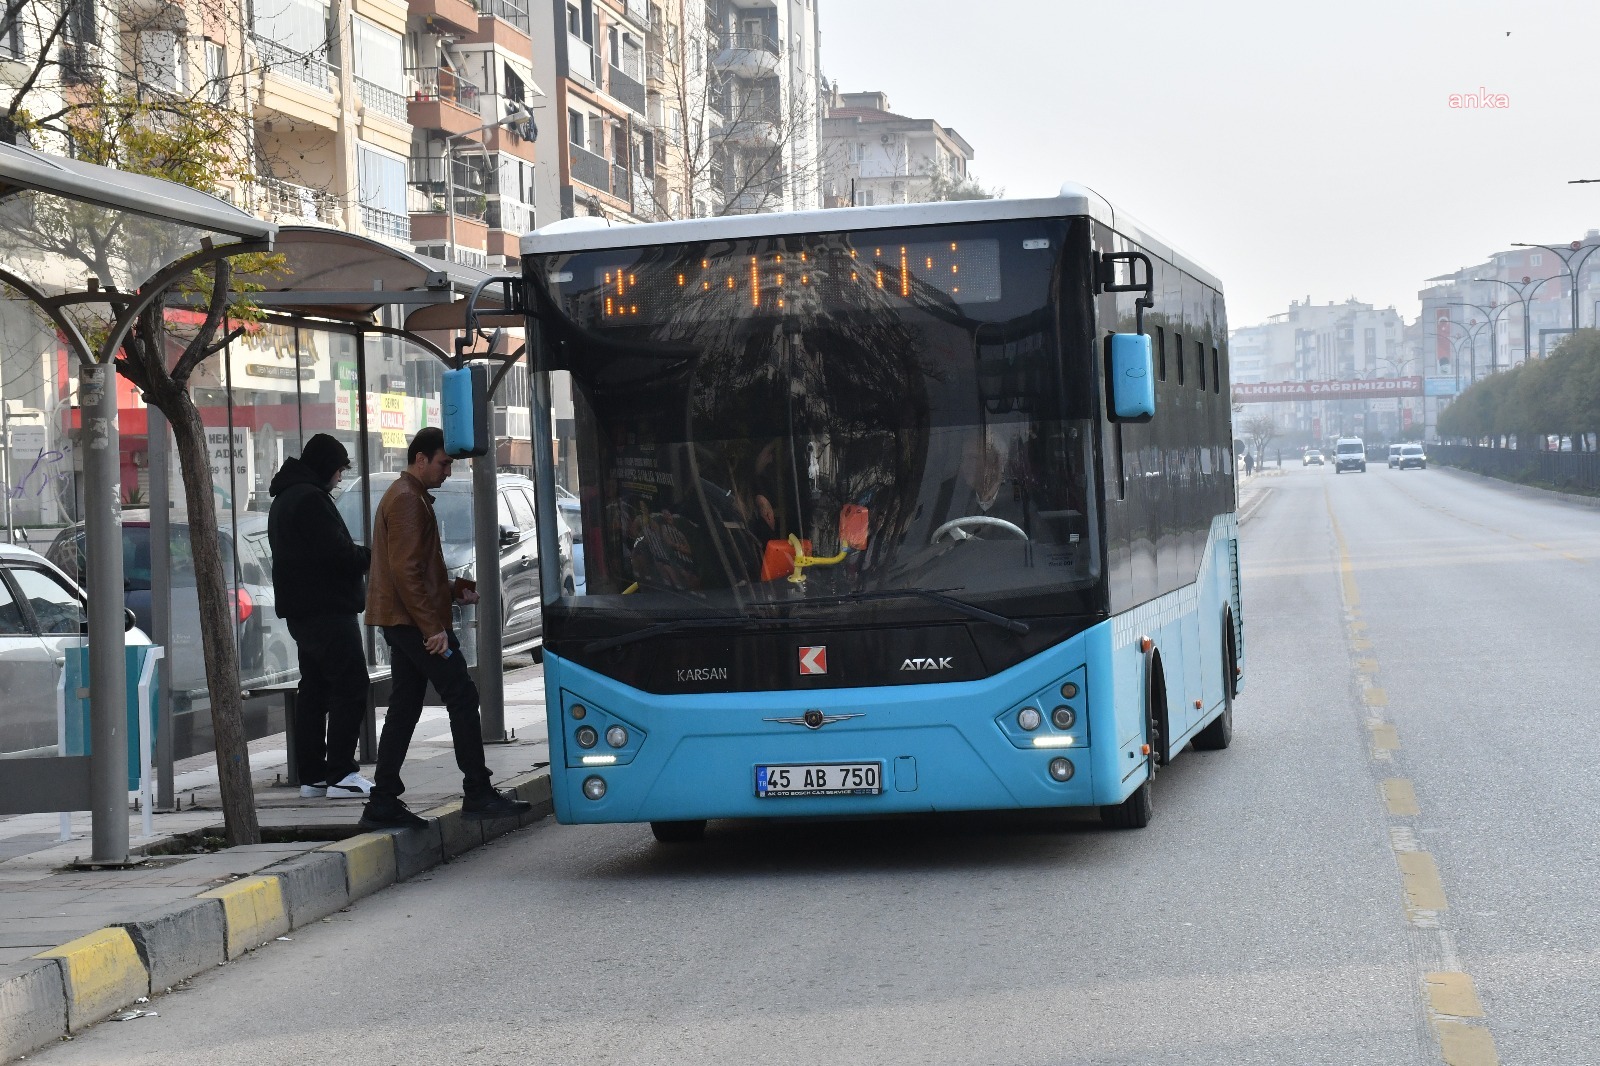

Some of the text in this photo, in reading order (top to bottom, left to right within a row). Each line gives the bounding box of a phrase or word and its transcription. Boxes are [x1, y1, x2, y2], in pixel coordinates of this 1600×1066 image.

[381, 412, 404, 428] KIRALIK
[899, 656, 954, 671] ATAK
[677, 667, 727, 681] KARSAN
[767, 767, 876, 789] 45 AB 750
